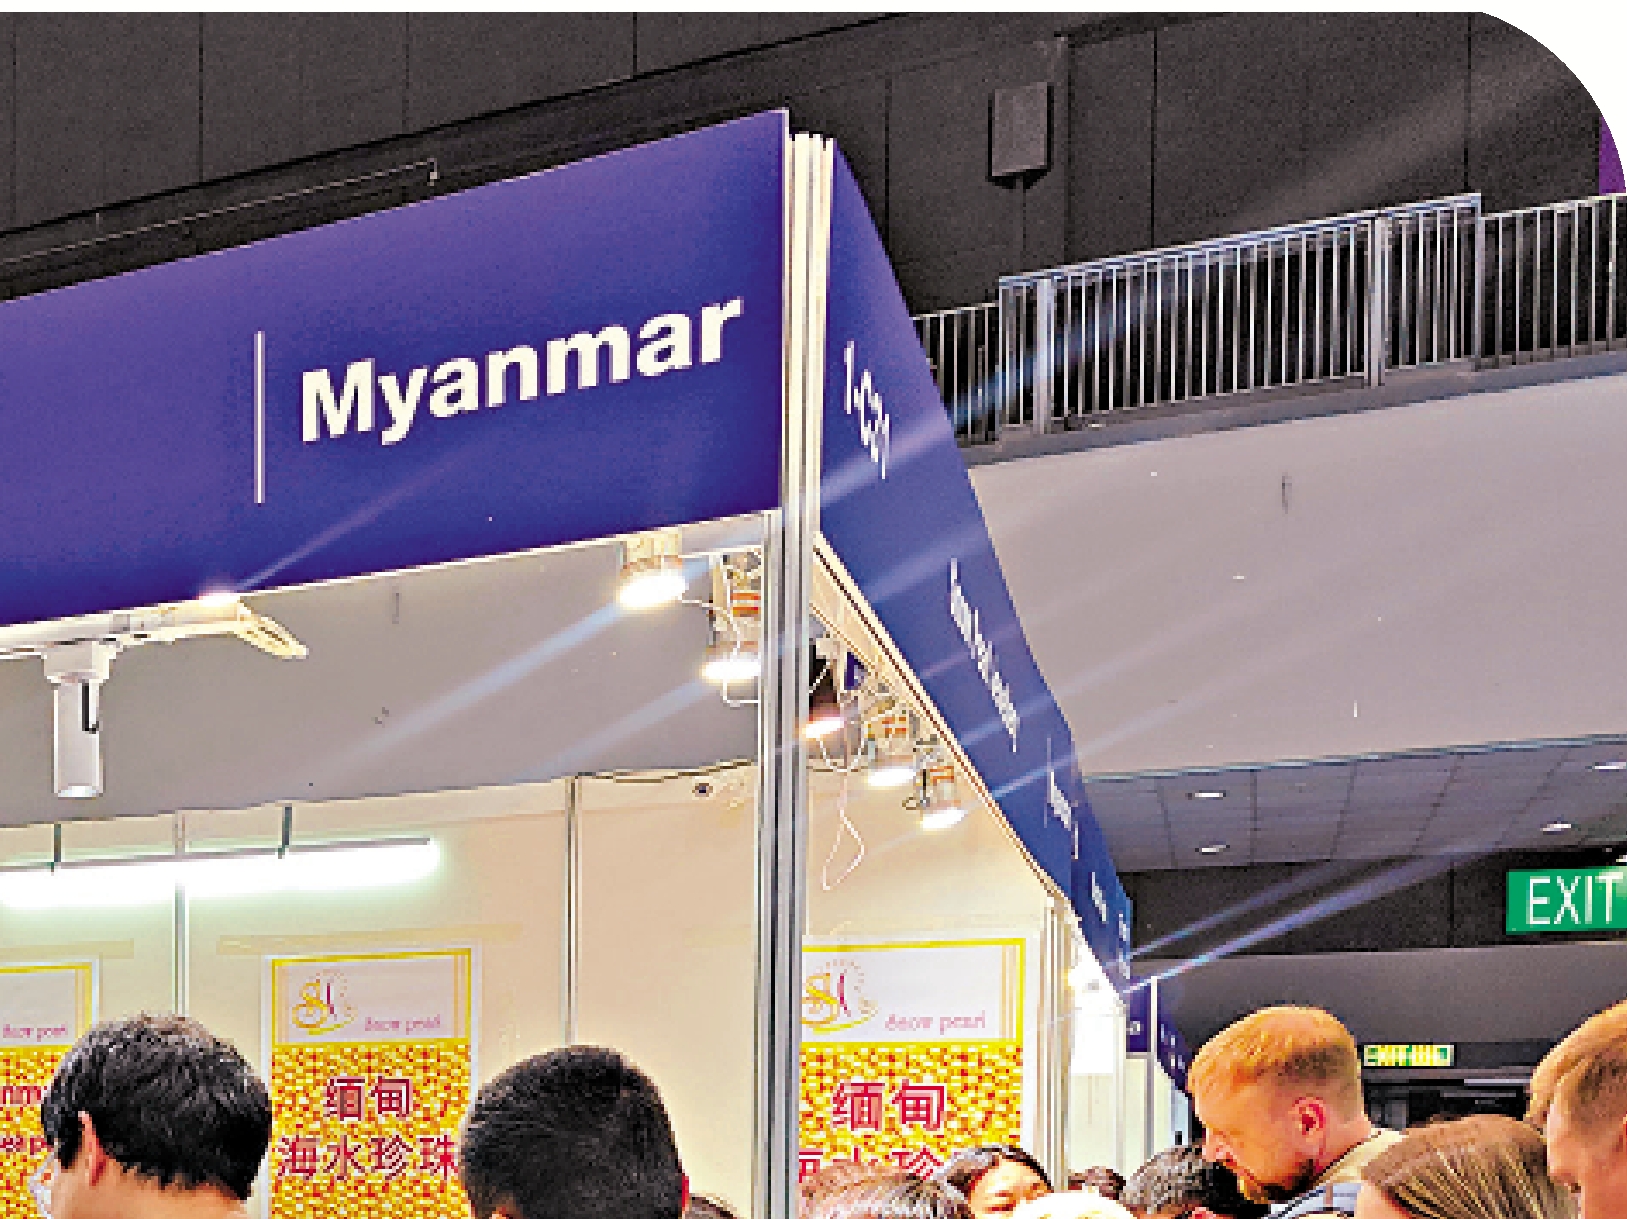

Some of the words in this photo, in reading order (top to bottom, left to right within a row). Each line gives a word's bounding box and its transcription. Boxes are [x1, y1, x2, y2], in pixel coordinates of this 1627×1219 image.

[302, 296, 744, 446] Myanmar
[1525, 871, 1624, 925] EXIT
[323, 1075, 411, 1121] 缅甸
[831, 1078, 946, 1131] 缅甸
[277, 1134, 459, 1182] 海水珍珠
